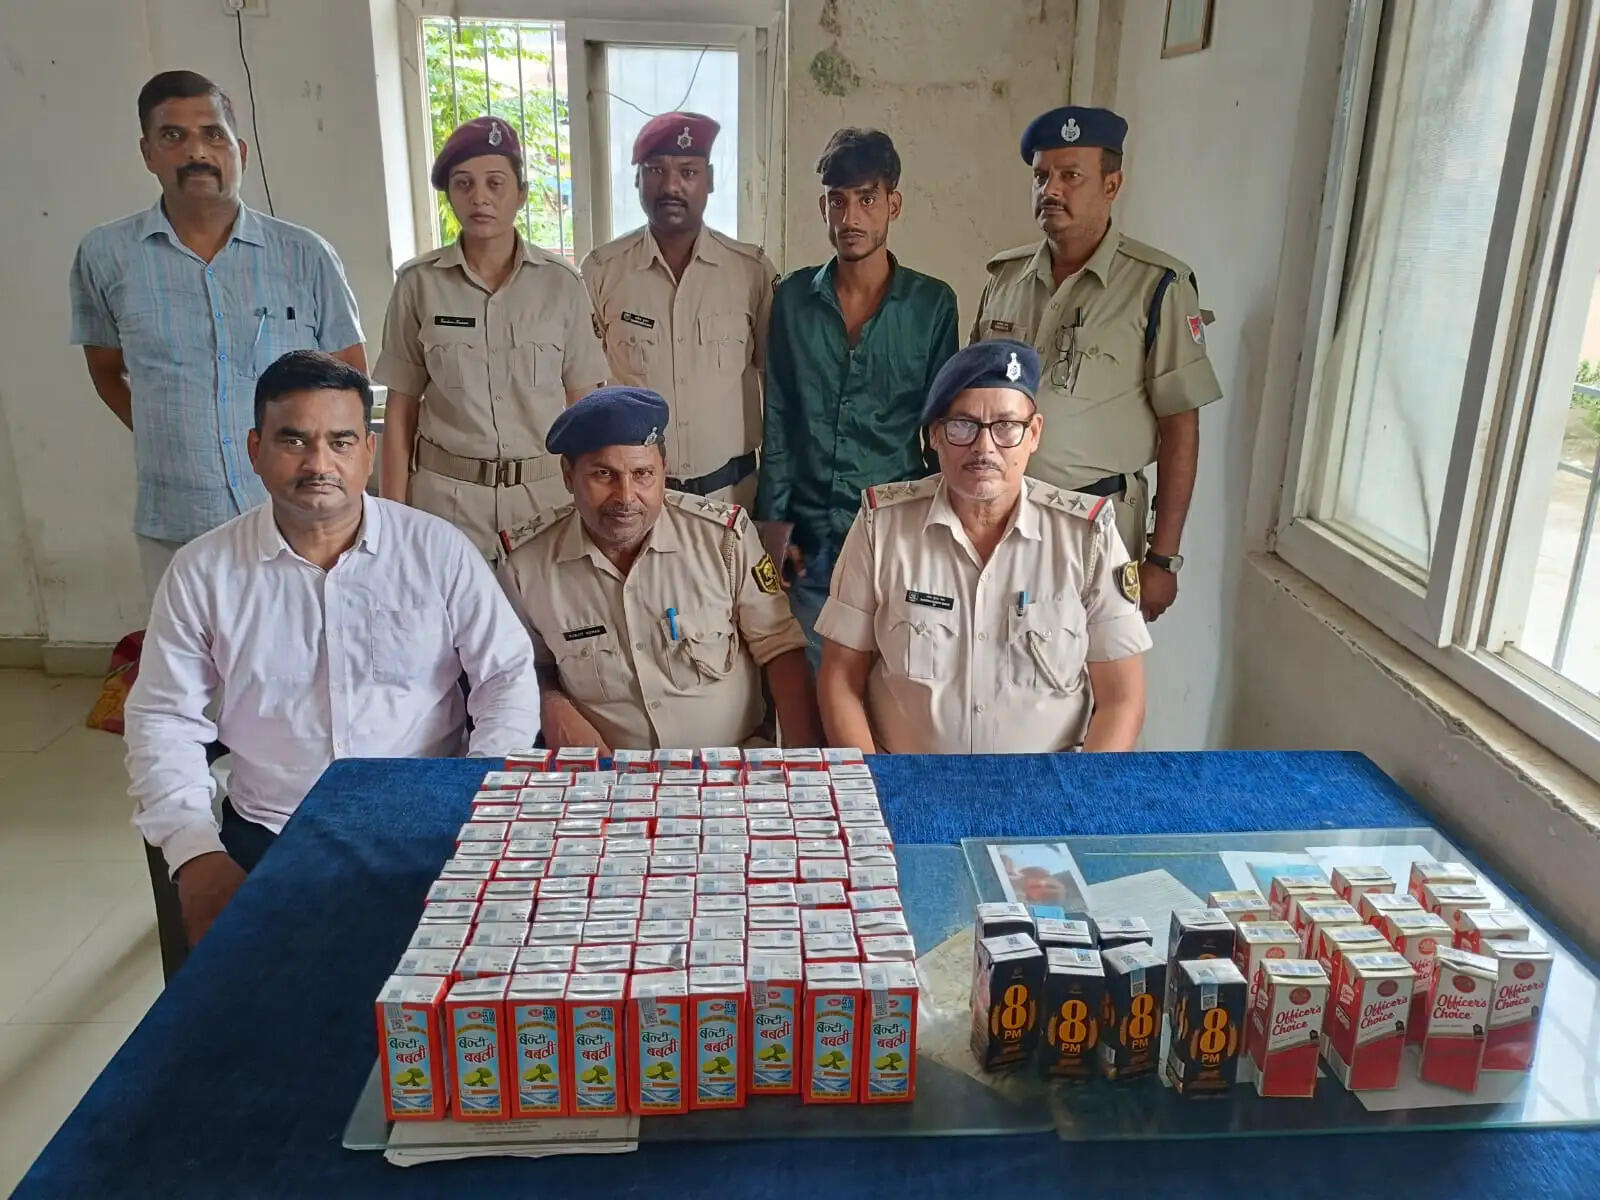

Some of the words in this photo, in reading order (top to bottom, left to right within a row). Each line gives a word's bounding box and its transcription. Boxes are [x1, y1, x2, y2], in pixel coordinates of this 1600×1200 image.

[1002, 984, 1028, 1030] 8
[1495, 996, 1530, 1011] Choice
[1129, 993, 1153, 1039] 8
[1361, 1012, 1395, 1030] Choice
[1433, 1007, 1473, 1020] Choice
[1059, 1000, 1087, 1043] 8
[1272, 1021, 1309, 1036] Choice
[1004, 1029, 1022, 1040] PM
[1199, 1008, 1228, 1053] 8
[1061, 1043, 1081, 1053] PM
[1132, 1038, 1149, 1050] PM
[1202, 1053, 1220, 1064] PM
